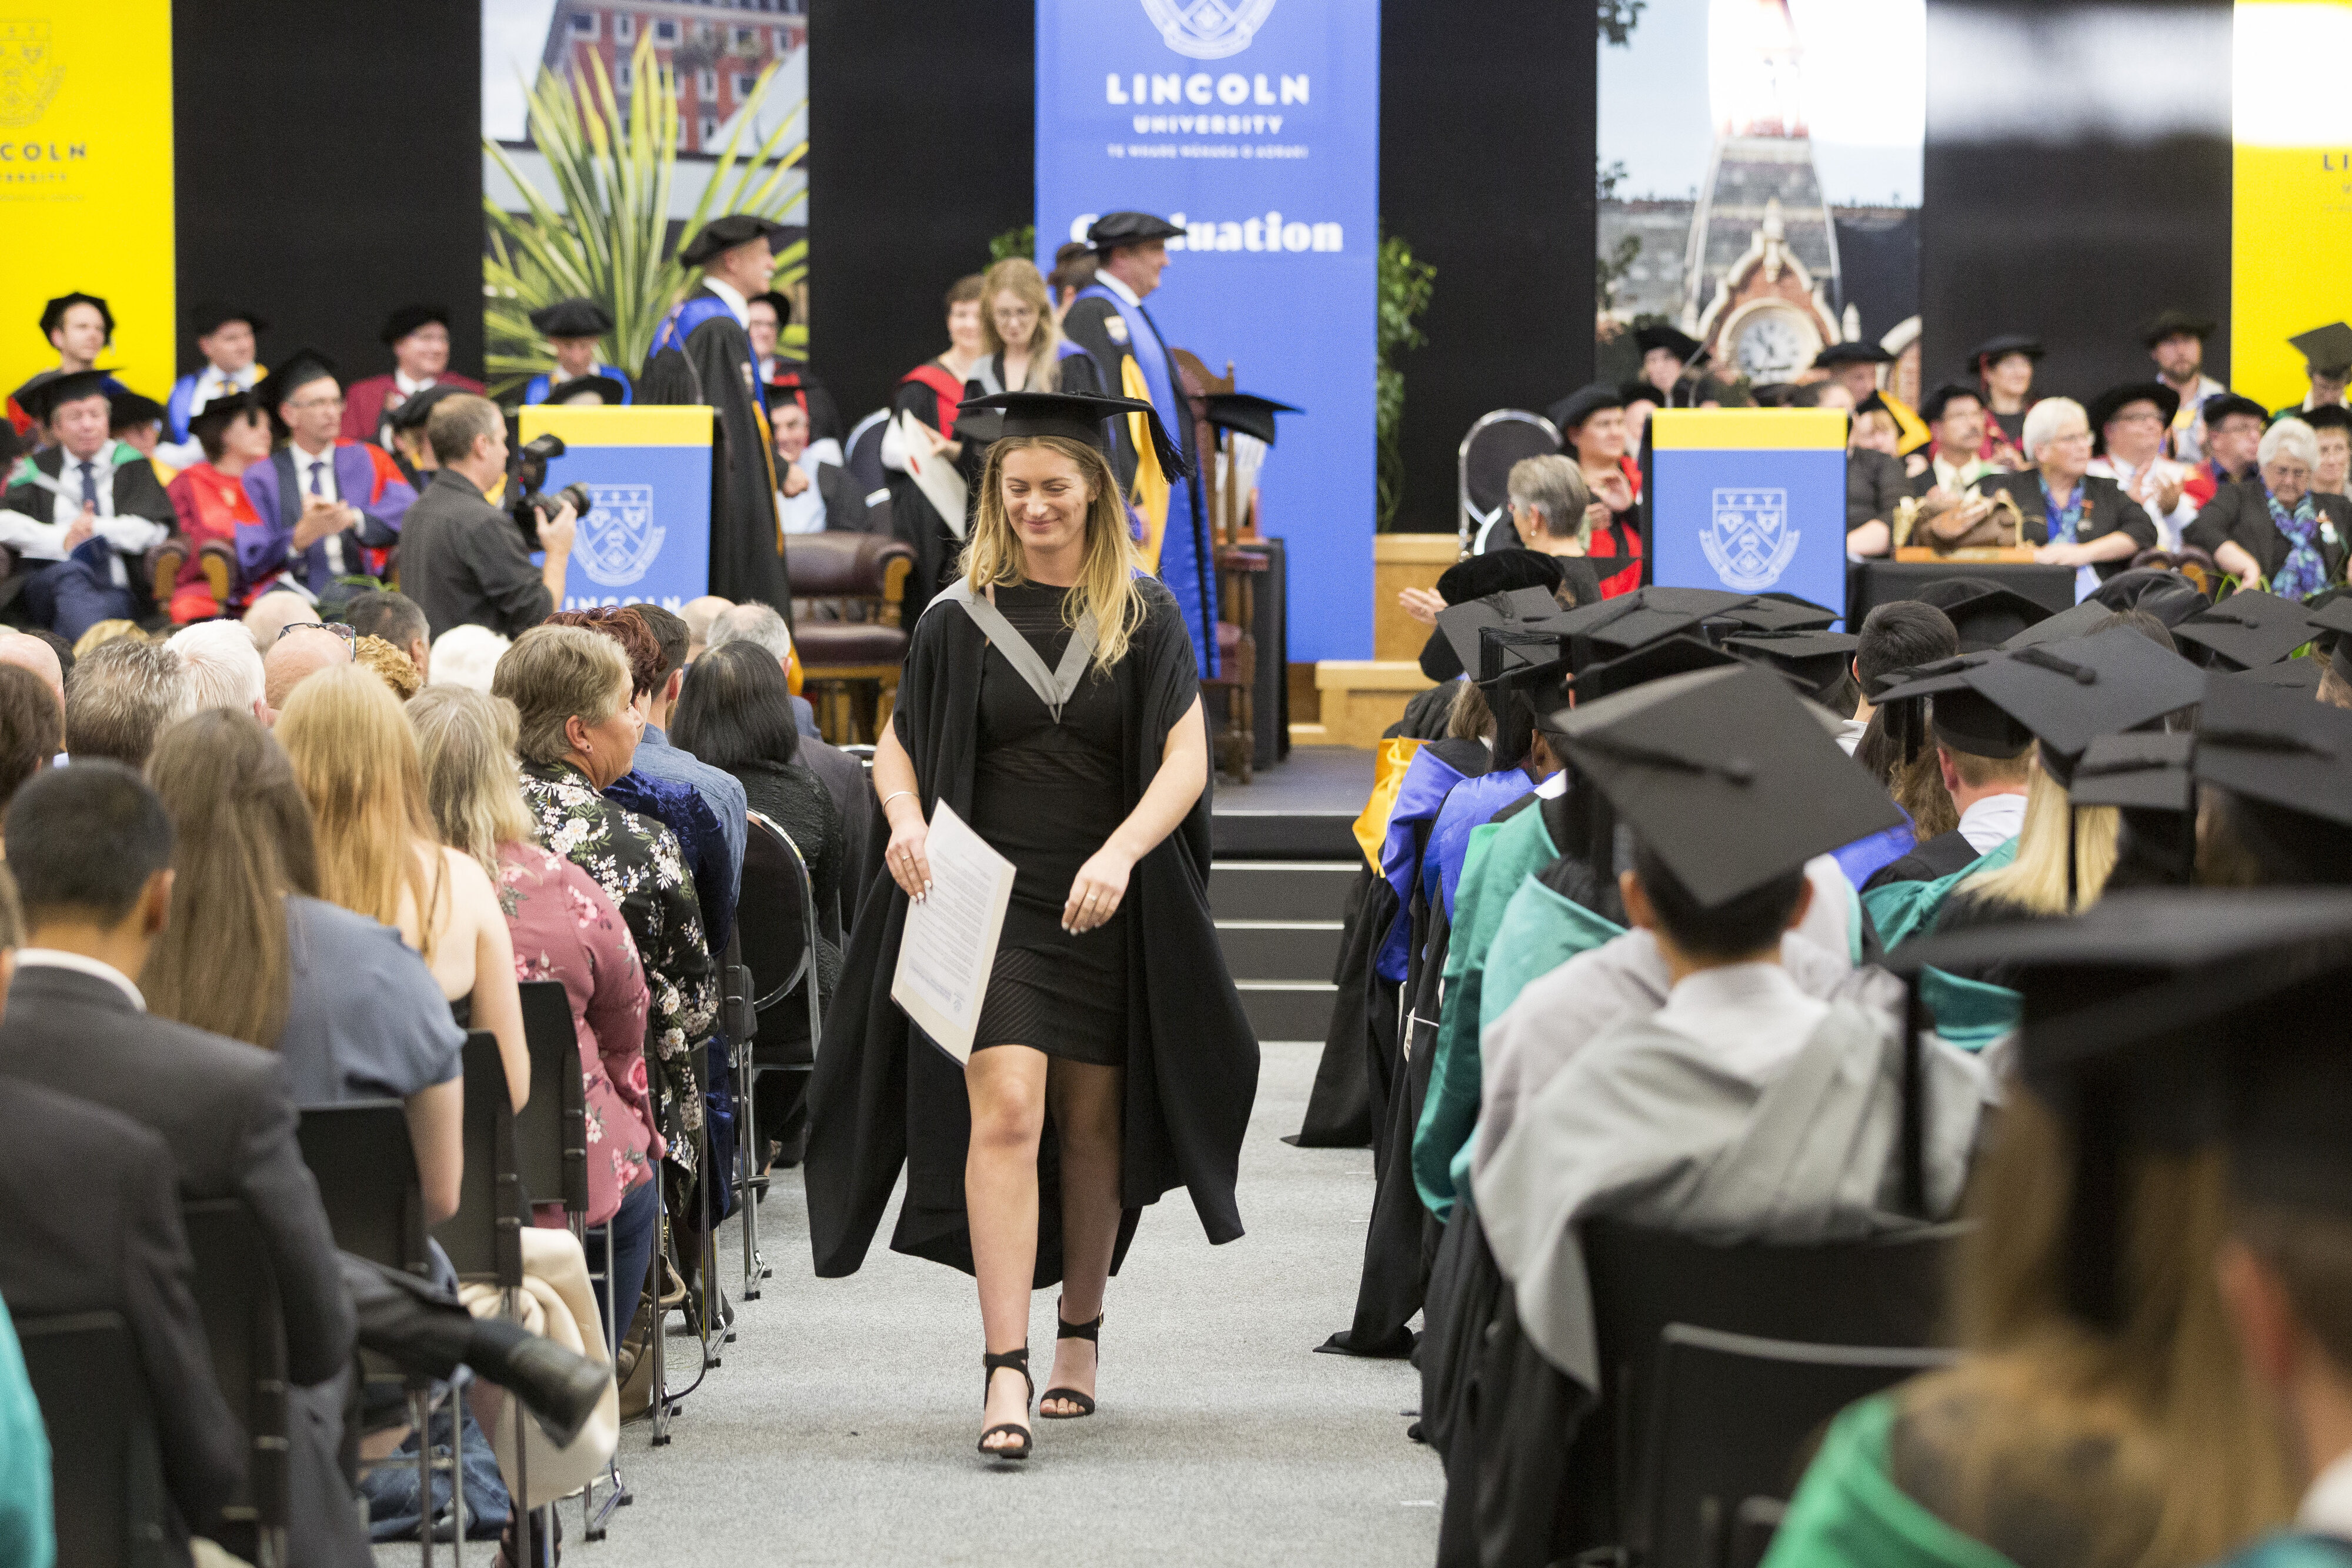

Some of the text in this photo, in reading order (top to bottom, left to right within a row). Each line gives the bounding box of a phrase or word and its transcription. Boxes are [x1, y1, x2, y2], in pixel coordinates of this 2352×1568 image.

[1106, 73, 1310, 105] LINCOLN
[1133, 115, 1283, 135] UNIVERSITY
[1070, 211, 1343, 252] Guation
